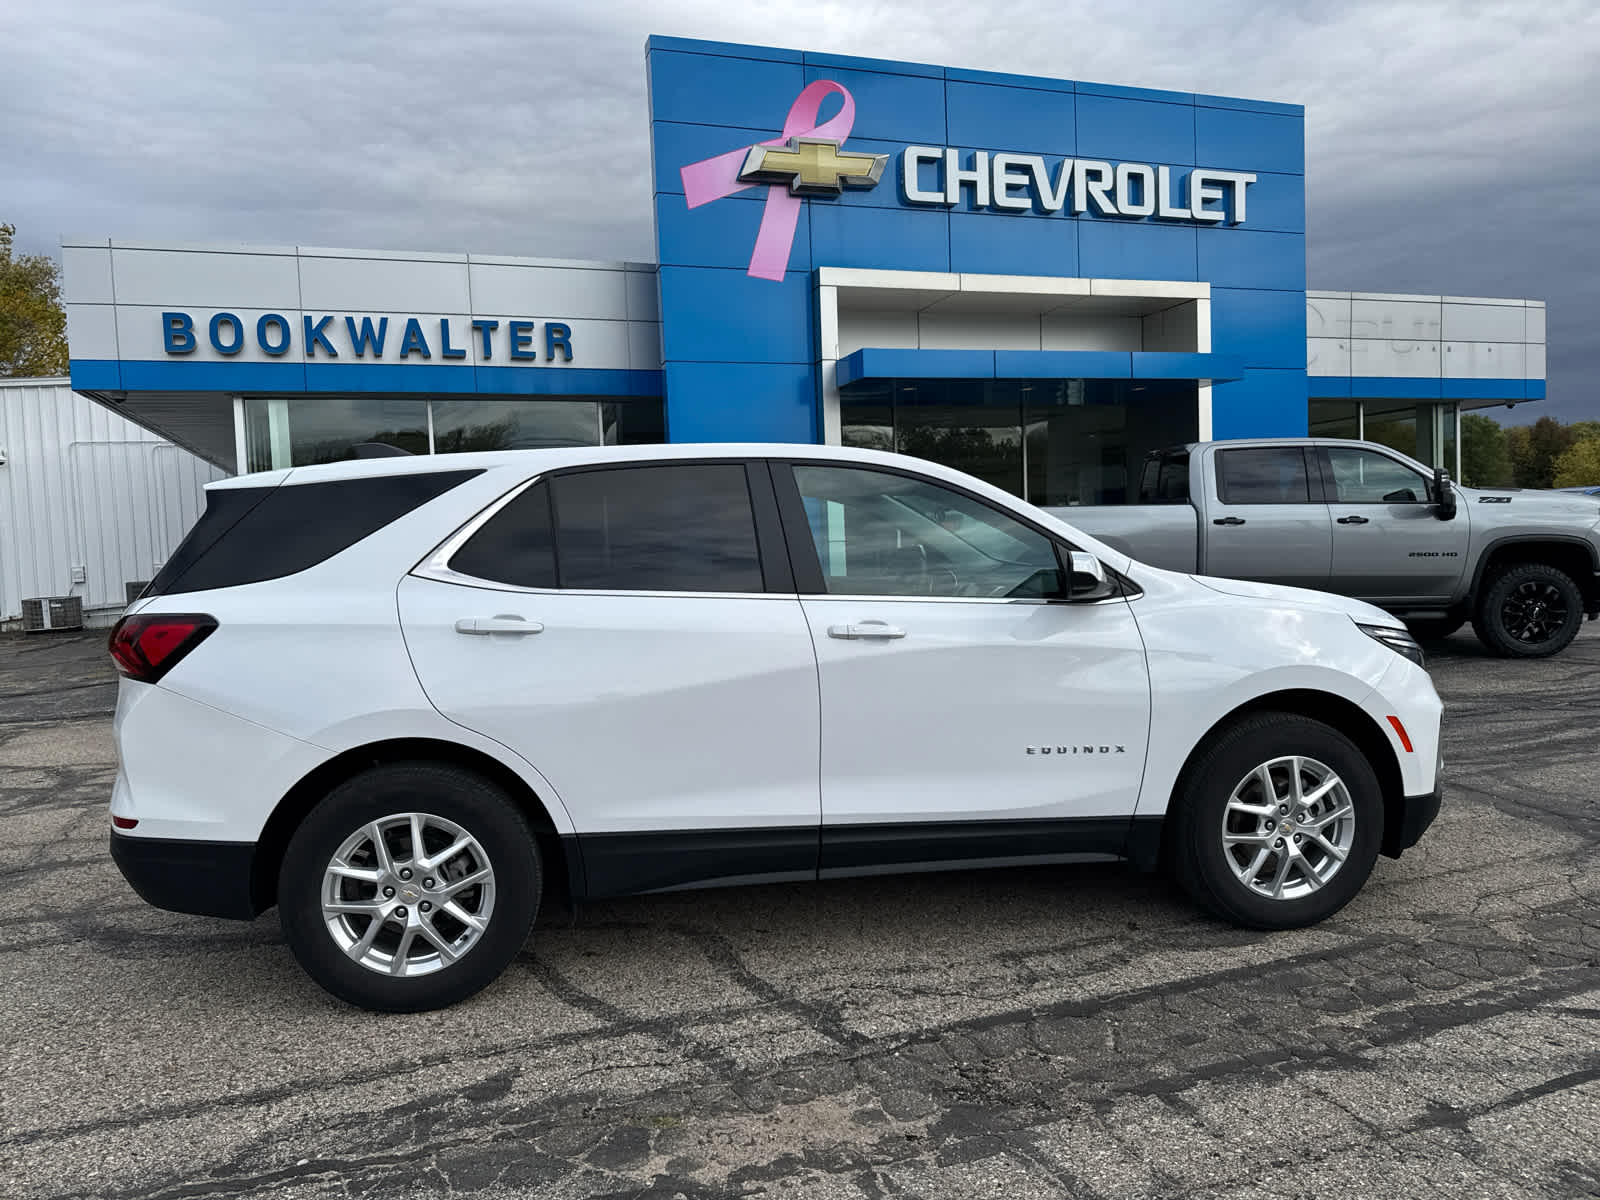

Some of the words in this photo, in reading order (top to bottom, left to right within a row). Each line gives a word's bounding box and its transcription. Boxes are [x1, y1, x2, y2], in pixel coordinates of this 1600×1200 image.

[902, 145, 1257, 225] CHEVROLET
[162, 311, 574, 362] BOOKWALTER
[1026, 745, 1126, 755] EQUINOX
